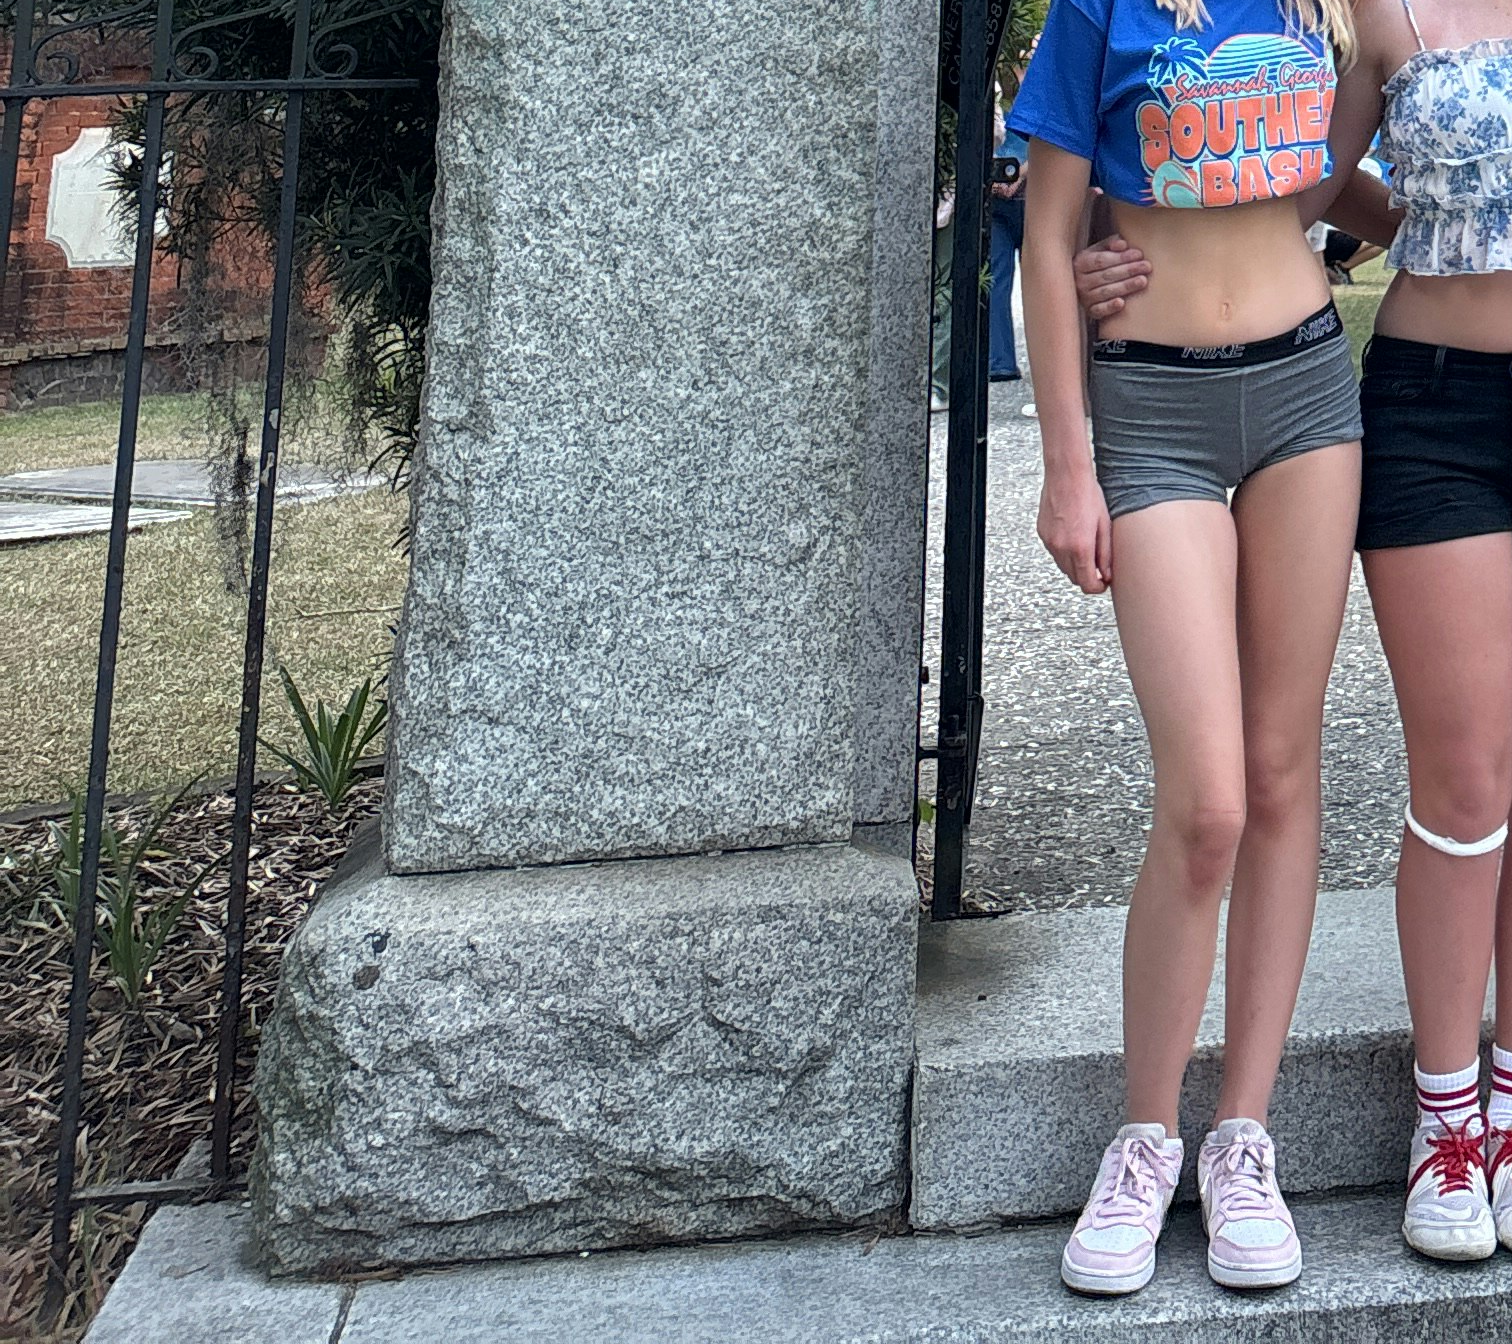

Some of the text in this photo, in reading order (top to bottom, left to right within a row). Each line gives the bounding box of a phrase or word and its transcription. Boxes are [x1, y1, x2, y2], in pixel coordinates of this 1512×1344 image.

[1175, 64, 1275, 102] Savannah,
[1200, 147, 1324, 208] BASH
[1293, 307, 1338, 346] NIKE
[1181, 344, 1246, 360] NIKE
